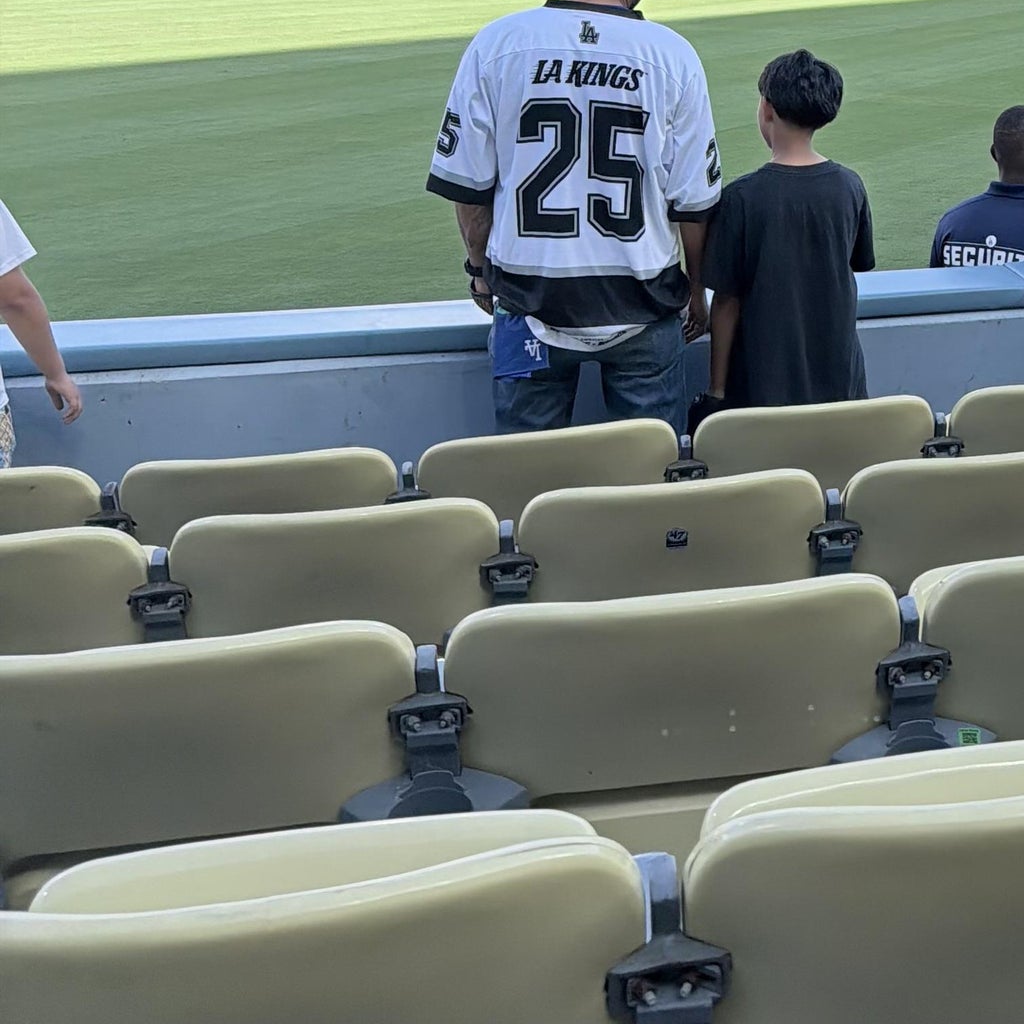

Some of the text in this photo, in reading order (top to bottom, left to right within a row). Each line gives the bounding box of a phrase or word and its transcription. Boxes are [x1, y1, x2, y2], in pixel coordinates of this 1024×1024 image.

[579, 20, 600, 45] LA
[531, 59, 645, 92] LA KINGS
[516, 97, 650, 242] 25
